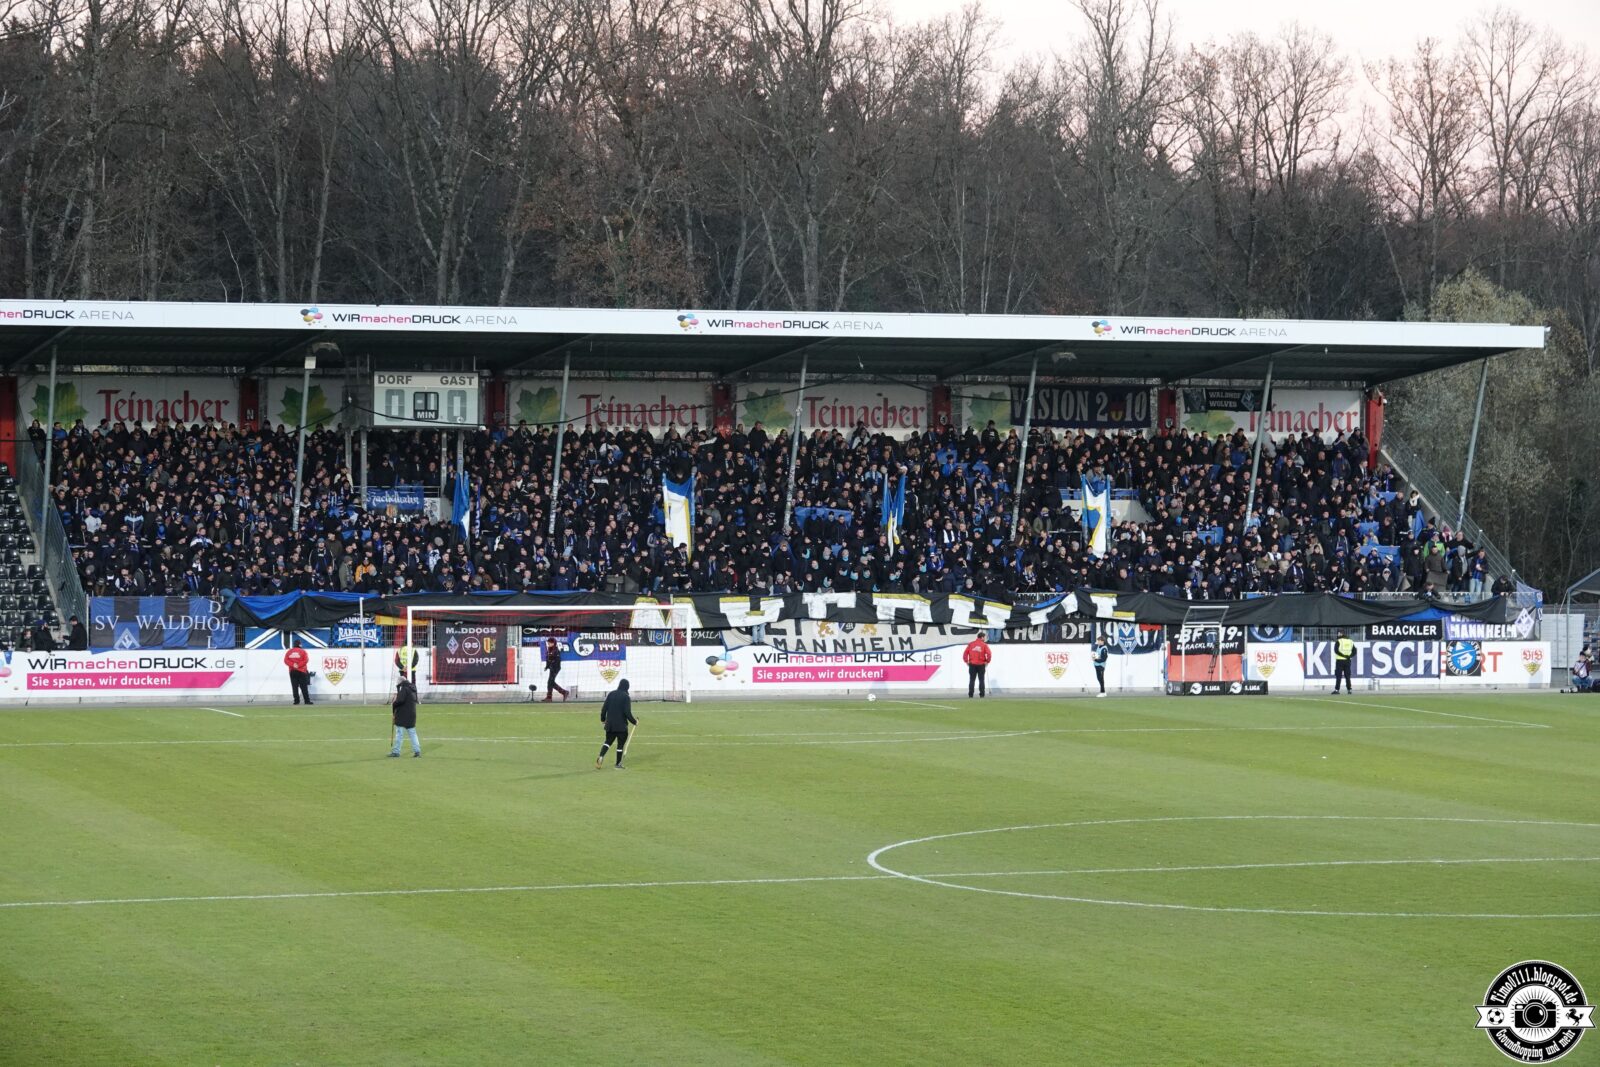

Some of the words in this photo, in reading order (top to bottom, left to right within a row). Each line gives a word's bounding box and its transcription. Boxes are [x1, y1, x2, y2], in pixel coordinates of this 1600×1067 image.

[79, 310, 135, 320] ARENA
[332, 312, 461, 324] WIRmachenDRUCK
[465, 314, 518, 325] ARENA
[707, 318, 830, 330] WIRmachenDRUCK
[833, 320, 884, 330] ARENA
[1120, 325, 1237, 336] WIRmachenDRUCK
[1239, 327, 1288, 337] ARENA
[377, 374, 413, 385] DORF
[439, 375, 475, 386] GAST
[97, 389, 230, 424] Teinacher
[577, 393, 705, 427] Teinacher
[803, 395, 926, 429] Teinacher
[416, 411, 436, 419] MIN
[95, 615, 120, 631] SV
[136, 614, 230, 632] WALDHOF
[445, 626, 497, 634] MDDOGS
[579, 631, 633, 641] Mannheim
[1371, 624, 1437, 636] BARACKLER
[1450, 623, 1518, 638] MANNHEIM
[464, 641, 479, 649] 95
[772, 636, 914, 653] MANNHEIM
[445, 657, 497, 665] WALDHOF
[1306, 641, 1439, 676] KTSCH
[757, 669, 773, 680] Sie
[776, 671, 815, 682] sparen,
[818, 669, 834, 680] wir
[837, 669, 884, 679] drucken!
[31, 676, 49, 687] Sie
[52, 678, 96, 690] sparen,
[99, 676, 117, 686] wir
[120, 675, 171, 686] drucken!
